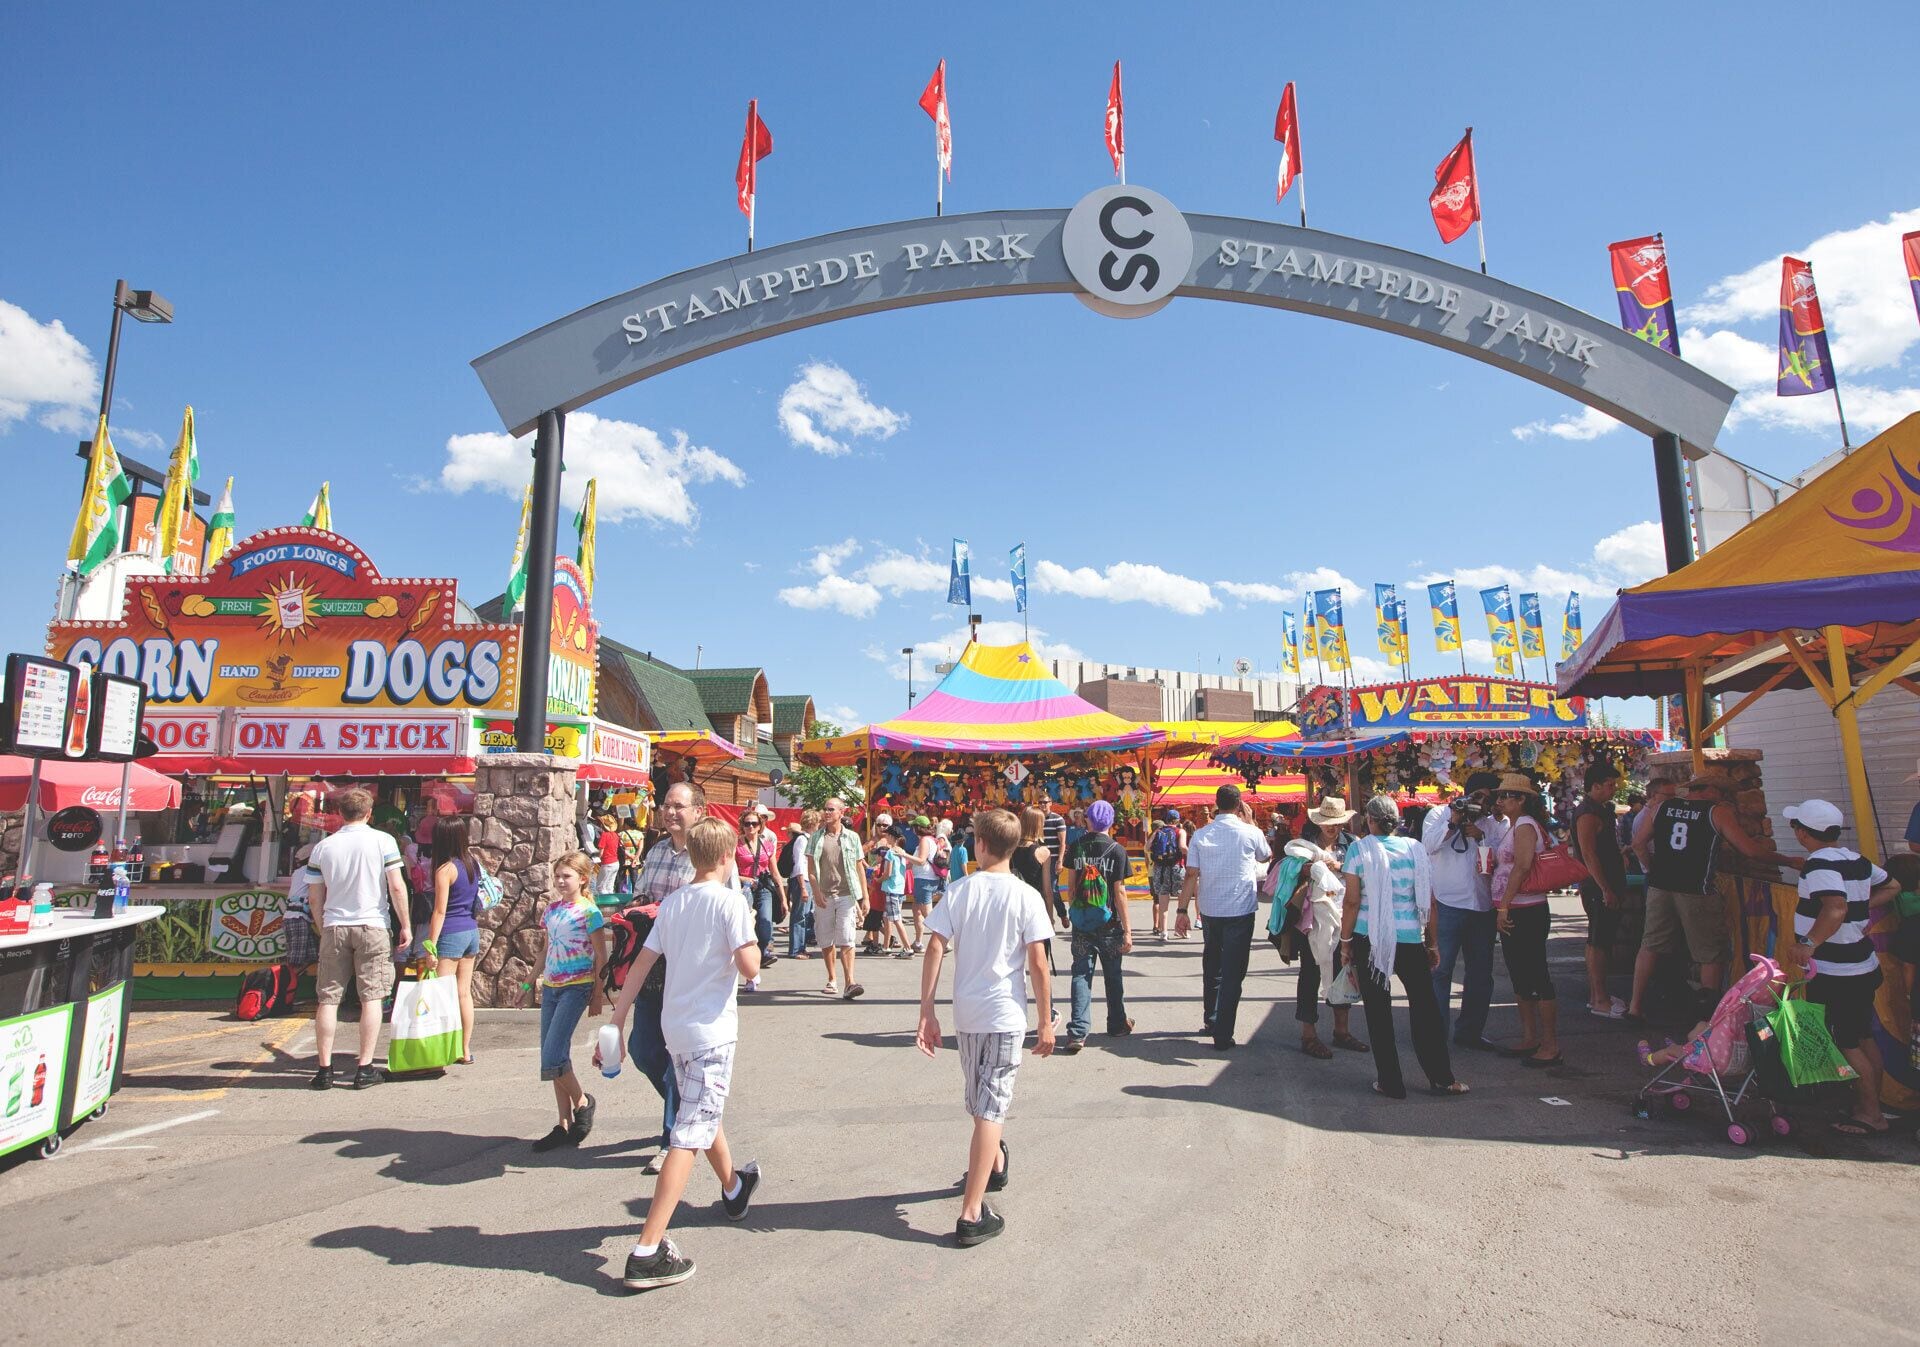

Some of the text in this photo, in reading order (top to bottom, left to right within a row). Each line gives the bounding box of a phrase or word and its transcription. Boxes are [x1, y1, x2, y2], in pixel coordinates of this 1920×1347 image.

[622, 232, 1035, 346] STAMPEDE PARK
[1218, 239, 1602, 369] STAMPEDE PARK
[241, 546, 348, 572] FOOT LONGS
[220, 601, 364, 613] FRESH SQUEEZED
[220, 666, 340, 678] HAND DIPPED
[344, 639, 501, 703] DOGS
[248, 689, 293, 700] Campbell's
[1357, 682, 1578, 722] WATER
[1424, 711, 1517, 721] GAME
[240, 723, 289, 749] ON
[301, 723, 324, 749] A
[340, 723, 449, 749] STICK
[602, 736, 637, 763] CORN DOGS
[1008, 763, 1019, 780] $1
[81, 786, 136, 806] Coca-Co
[1670, 822, 1688, 850] 8
[216, 932, 287, 956] DOGS
